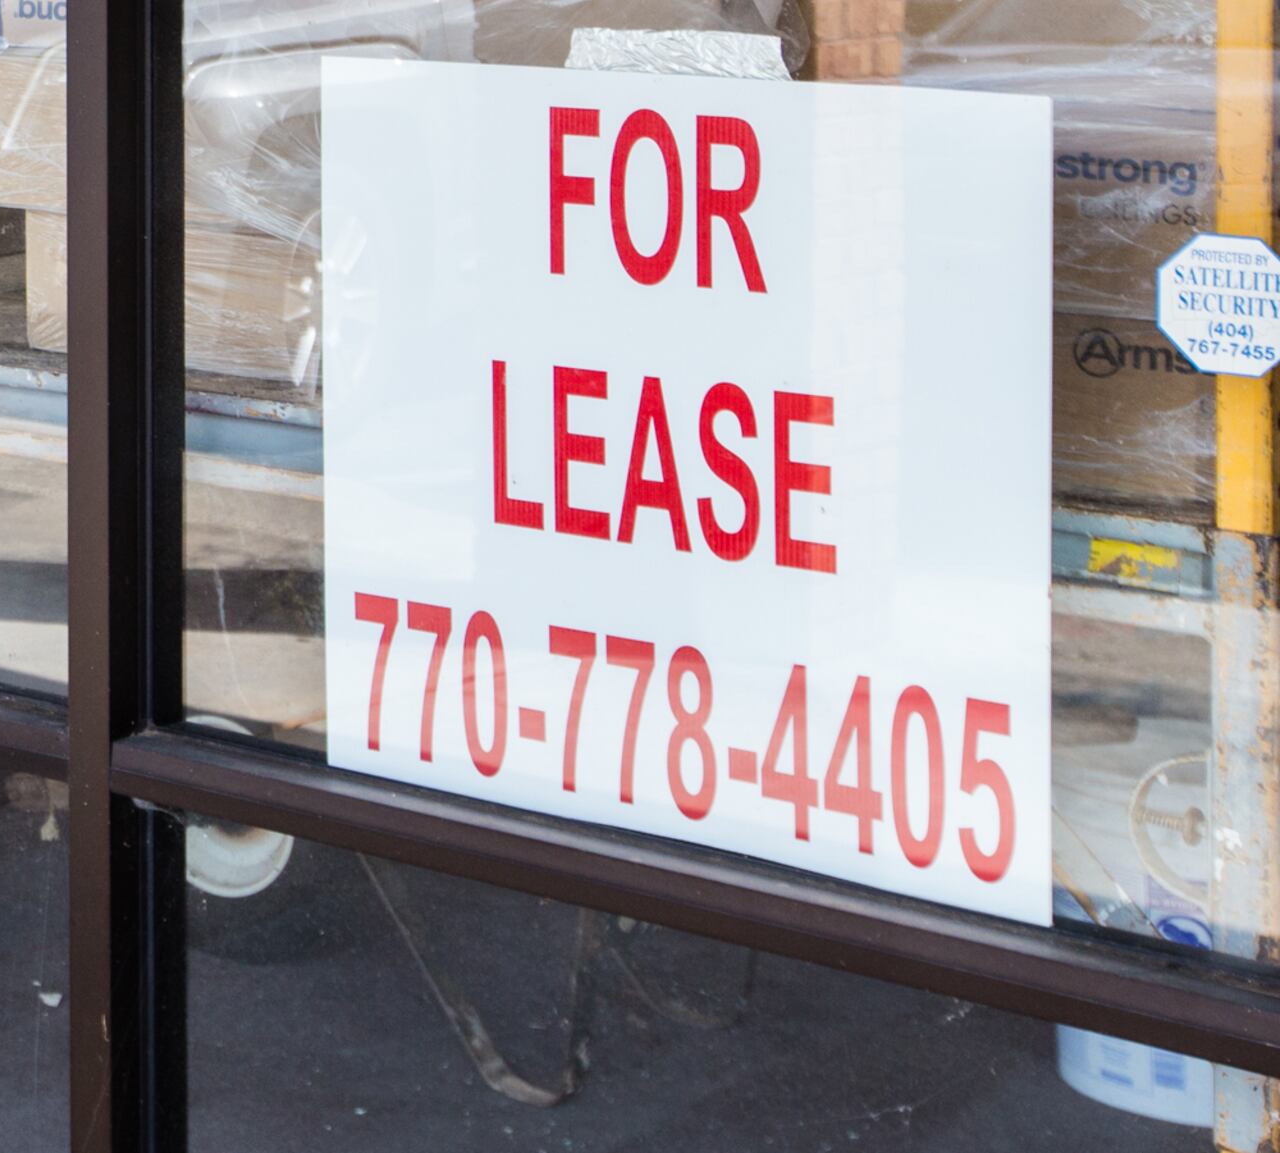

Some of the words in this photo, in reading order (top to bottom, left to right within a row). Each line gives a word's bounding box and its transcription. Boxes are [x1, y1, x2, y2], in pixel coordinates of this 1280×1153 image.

[548, 106, 768, 294] FOR
[1191, 249, 1253, 265] PROTECTED
[1255, 254, 1269, 267] BY
[1177, 289, 1280, 319] SECURITY
[1207, 320, 1255, 342] (404)
[1187, 338, 1276, 361] 767-7455
[491, 359, 838, 575] LEASE
[354, 591, 1015, 884] 770-778-4405
